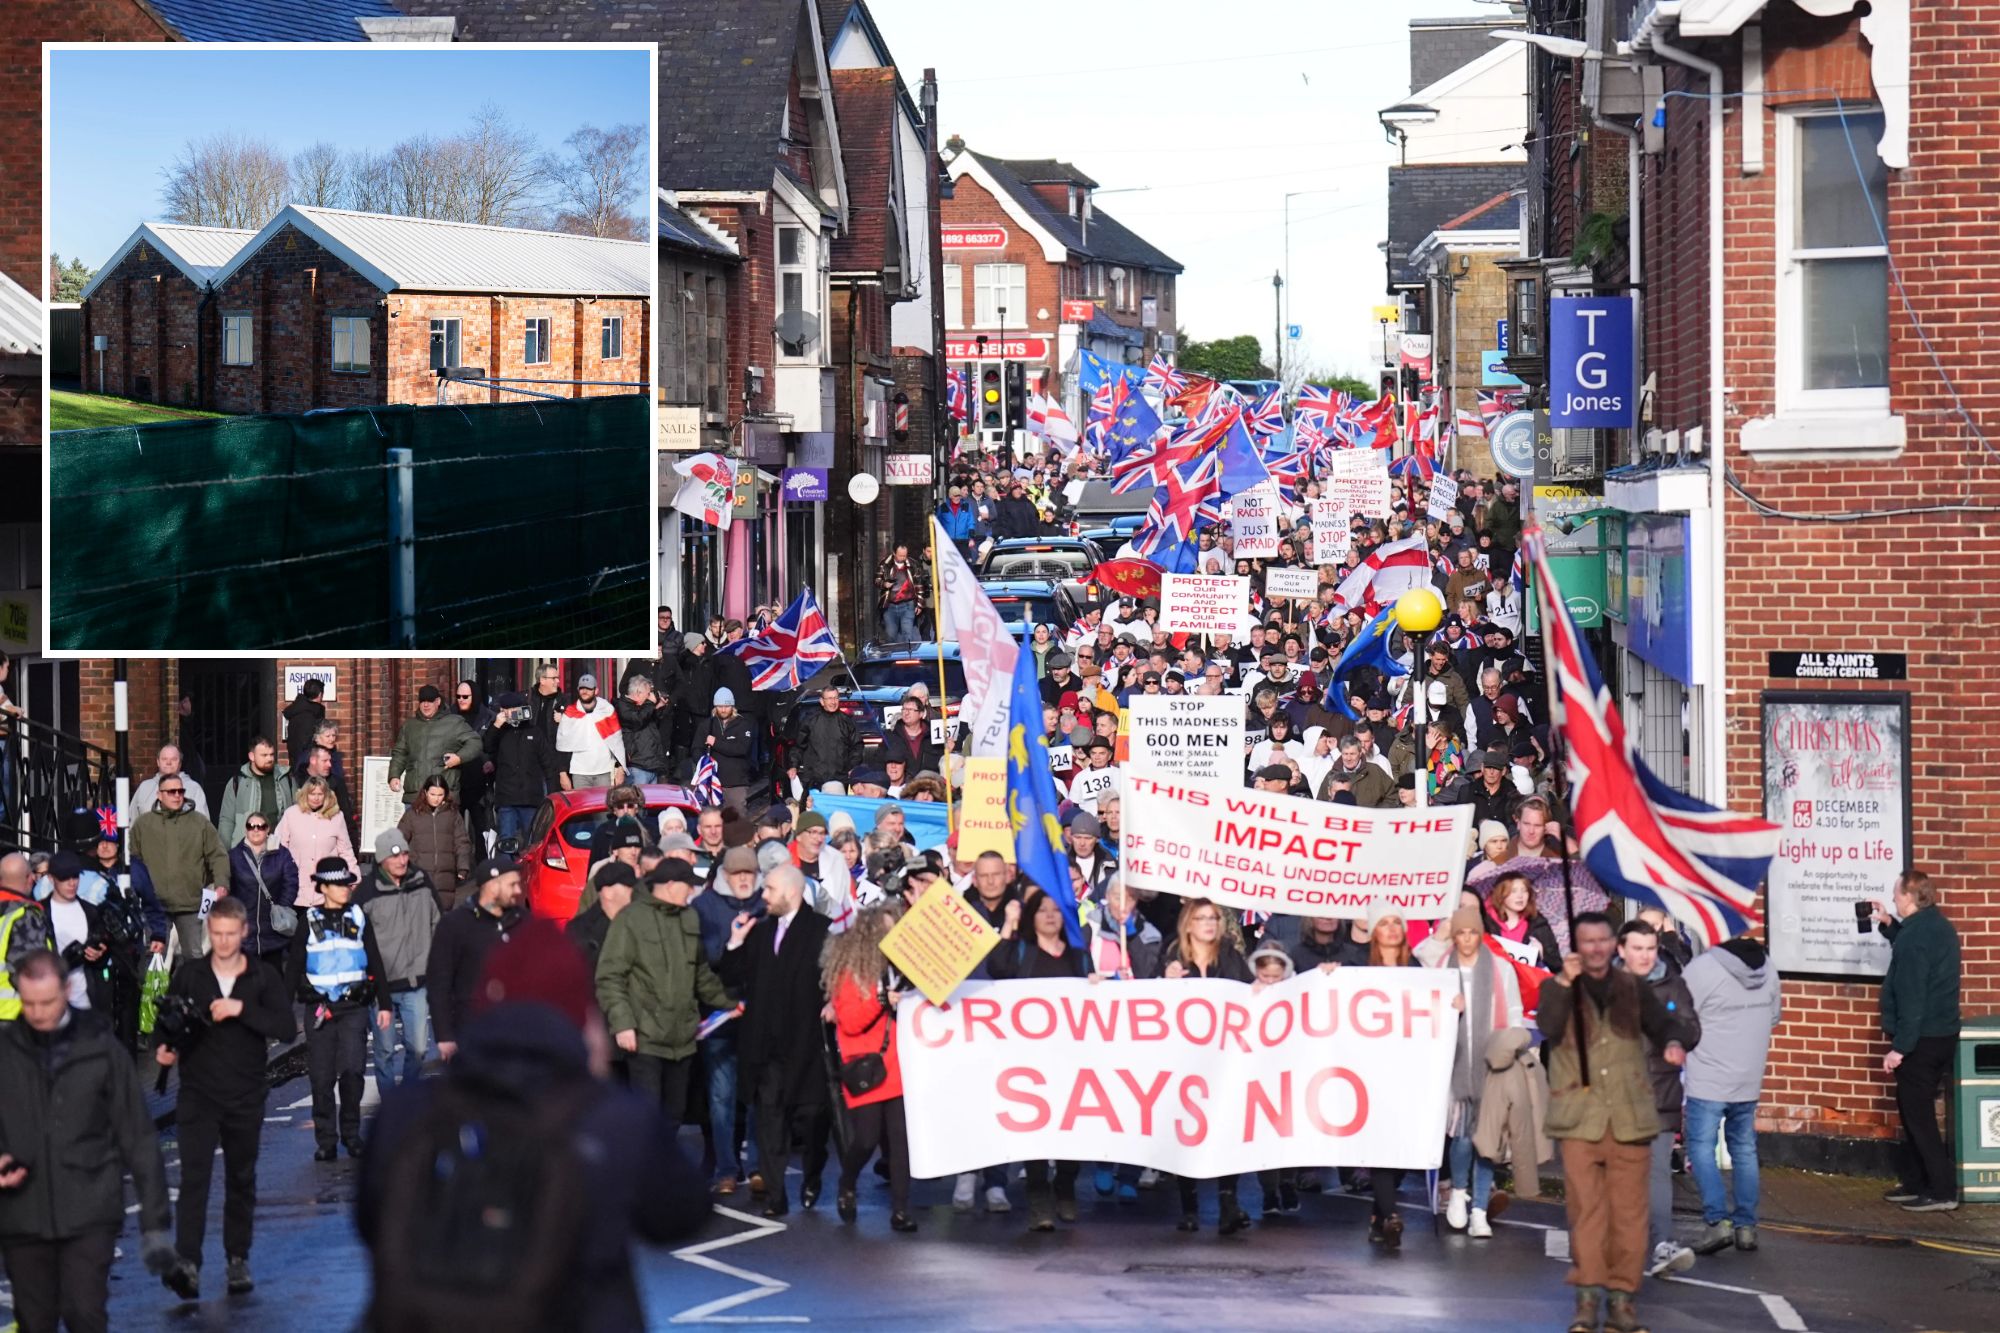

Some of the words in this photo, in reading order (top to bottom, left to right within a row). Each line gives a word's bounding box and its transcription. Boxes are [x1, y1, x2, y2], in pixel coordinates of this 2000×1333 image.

[966, 234, 1000, 243] 663377
[1576, 310, 1607, 346] T
[967, 343, 1026, 355] AGENTS
[1576, 352, 1607, 389] G
[1561, 393, 1621, 416] Jones
[661, 424, 697, 434] NAILS
[886, 462, 931, 476] NAILS
[1245, 498, 1263, 507] NOT
[1318, 502, 1345, 512] STOP
[1237, 508, 1271, 517] RACIST
[1315, 520, 1347, 528] MADNESS
[1242, 526, 1270, 535] JUST
[1320, 531, 1347, 543] STOP
[1236, 538, 1275, 549] AFRAID
[1321, 550, 1347, 558] BOATS
[1172, 577, 1239, 586] PROTECT
[1273, 573, 1311, 581] PROTECT
[1171, 592, 1237, 600] COMMUNITY
[1170, 606, 1238, 615] PROTECT
[1495, 603, 1515, 616] 211
[1170, 621, 1237, 630] FAMILIES
[1799, 653, 1824, 666] ALL
[1827, 654, 1874, 667] SAINTS
[289, 673, 332, 683] ASHDOWN
[1796, 667, 1837, 676] CHURCH
[1839, 667, 1878, 677] CENTRE
[1170, 702, 1205, 710] STOP
[1136, 717, 1167, 726] THIS
[1172, 717, 1238, 727] MADNESS
[1146, 734, 1180, 746] 600
[1187, 734, 1228, 747] MEN
[1773, 712, 1881, 758] CHRISTMAS
[1083, 775, 1111, 794] 138
[1130, 776, 1210, 806] THIS
[1226, 798, 1309, 825] WILL
[1324, 816, 1374, 834] BE
[1389, 818, 1454, 834] THE
[1796, 802, 1809, 811] SAT
[1816, 800, 1879, 813] DECEMBER
[1795, 812, 1811, 827] 06
[1816, 817, 1839, 829] 4.30
[1840, 816, 1855, 829] for
[1857, 817, 1880, 831] 5pm
[1215, 820, 1362, 862] IMPACT
[1779, 838, 1817, 863] Light
[1822, 846, 1842, 864] up
[1848, 847, 1858, 859] a
[1864, 840, 1893, 860] Life
[1126, 834, 1145, 849] OF
[1154, 839, 1191, 859] 600
[1198, 848, 1276, 877] ILLEGAL
[1283, 865, 1449, 886] UNDOCUMENTED
[1815, 871, 1858, 881] opportunity
[1859, 872, 1868, 880] to
[1126, 858, 1176, 879] MEN
[1186, 869, 1211, 887] IN
[1221, 877, 1276, 899] OUR
[1287, 889, 1447, 907] COMMNITY
[1788, 881, 1820, 890] celebrate
[1823, 882, 1833, 890] the
[1836, 883, 1852, 891] lives
[1854, 883, 1861, 891] of
[1863, 883, 1885, 892] loved
[944, 895, 983, 934] STOP
[912, 989, 1440, 1053] CROWBOROUGH
[996, 1066, 1208, 1147] SAYS
[1243, 1066, 1369, 1143] NO
